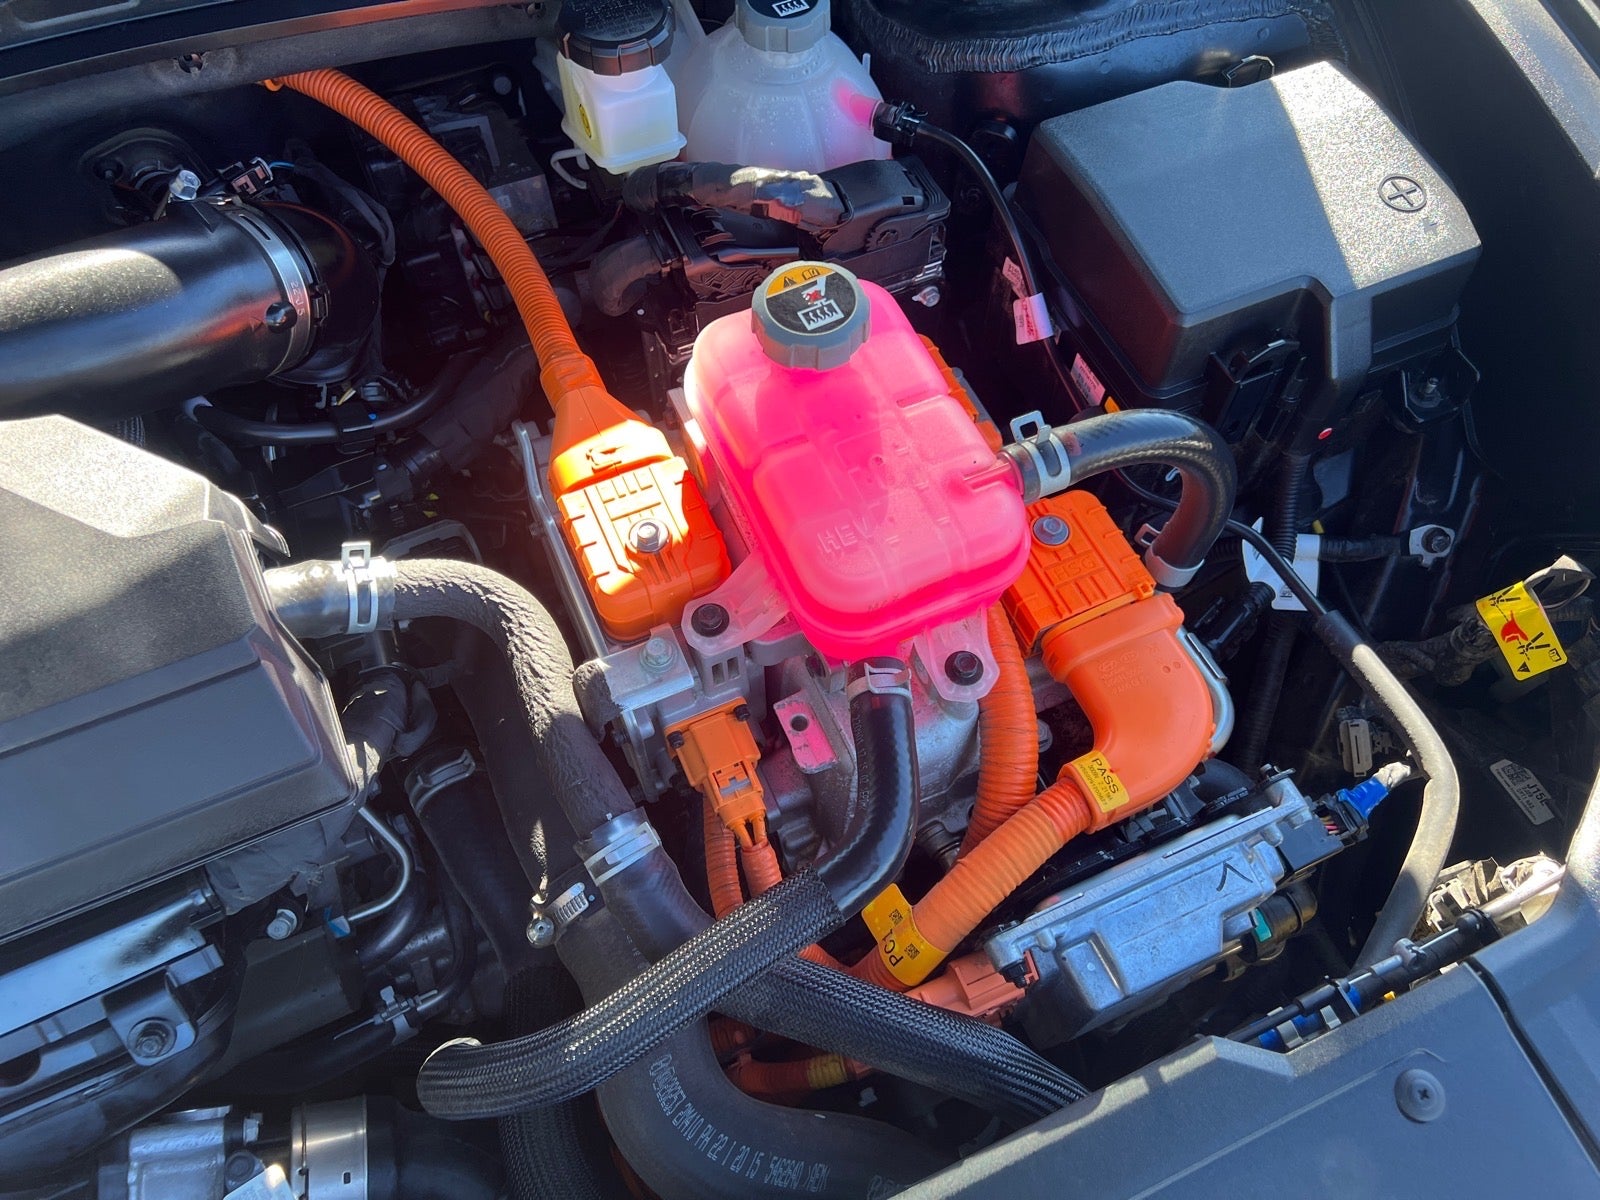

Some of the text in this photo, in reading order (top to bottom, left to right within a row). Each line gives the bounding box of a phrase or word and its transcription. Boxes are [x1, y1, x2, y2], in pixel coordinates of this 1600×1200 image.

[290, 281, 300, 295] 22
[817, 516, 870, 554] HEV
[1054, 554, 1096, 579] HSG
[1092, 758, 1119, 794] PASS
[707, 1134, 728, 1160] 22
[730, 1145, 750, 1173] 20
[745, 1152, 764, 1178] 15
